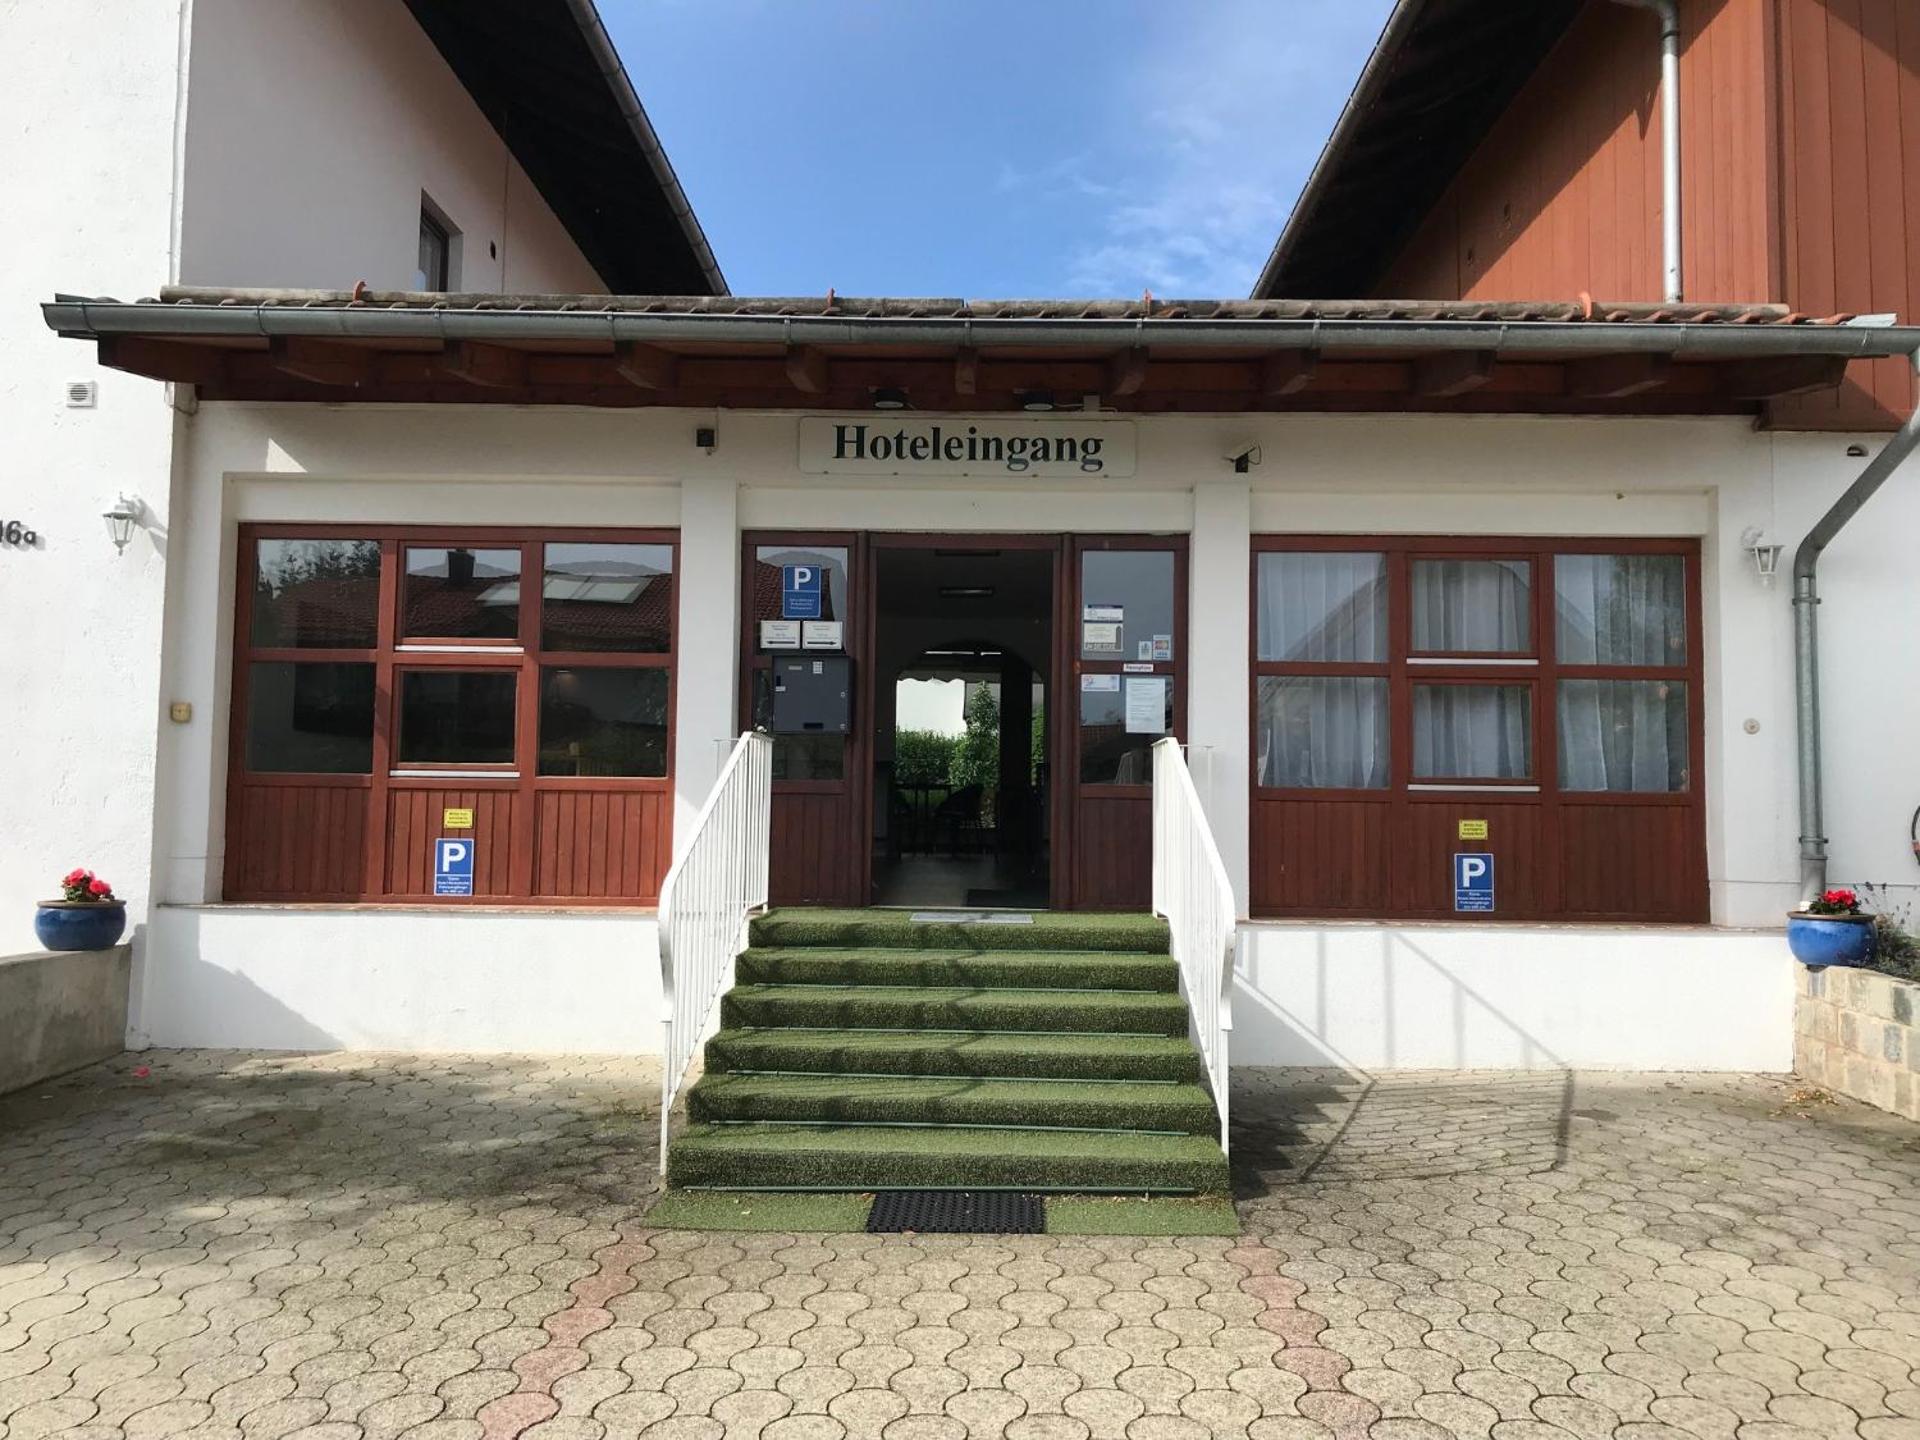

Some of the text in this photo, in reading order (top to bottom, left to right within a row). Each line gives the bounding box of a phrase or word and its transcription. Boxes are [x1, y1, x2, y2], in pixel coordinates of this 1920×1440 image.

[832, 424, 1104, 472] Hoteleingang
[794, 567, 812, 590] P
[443, 843, 466, 872] P
[1462, 858, 1486, 888] P
